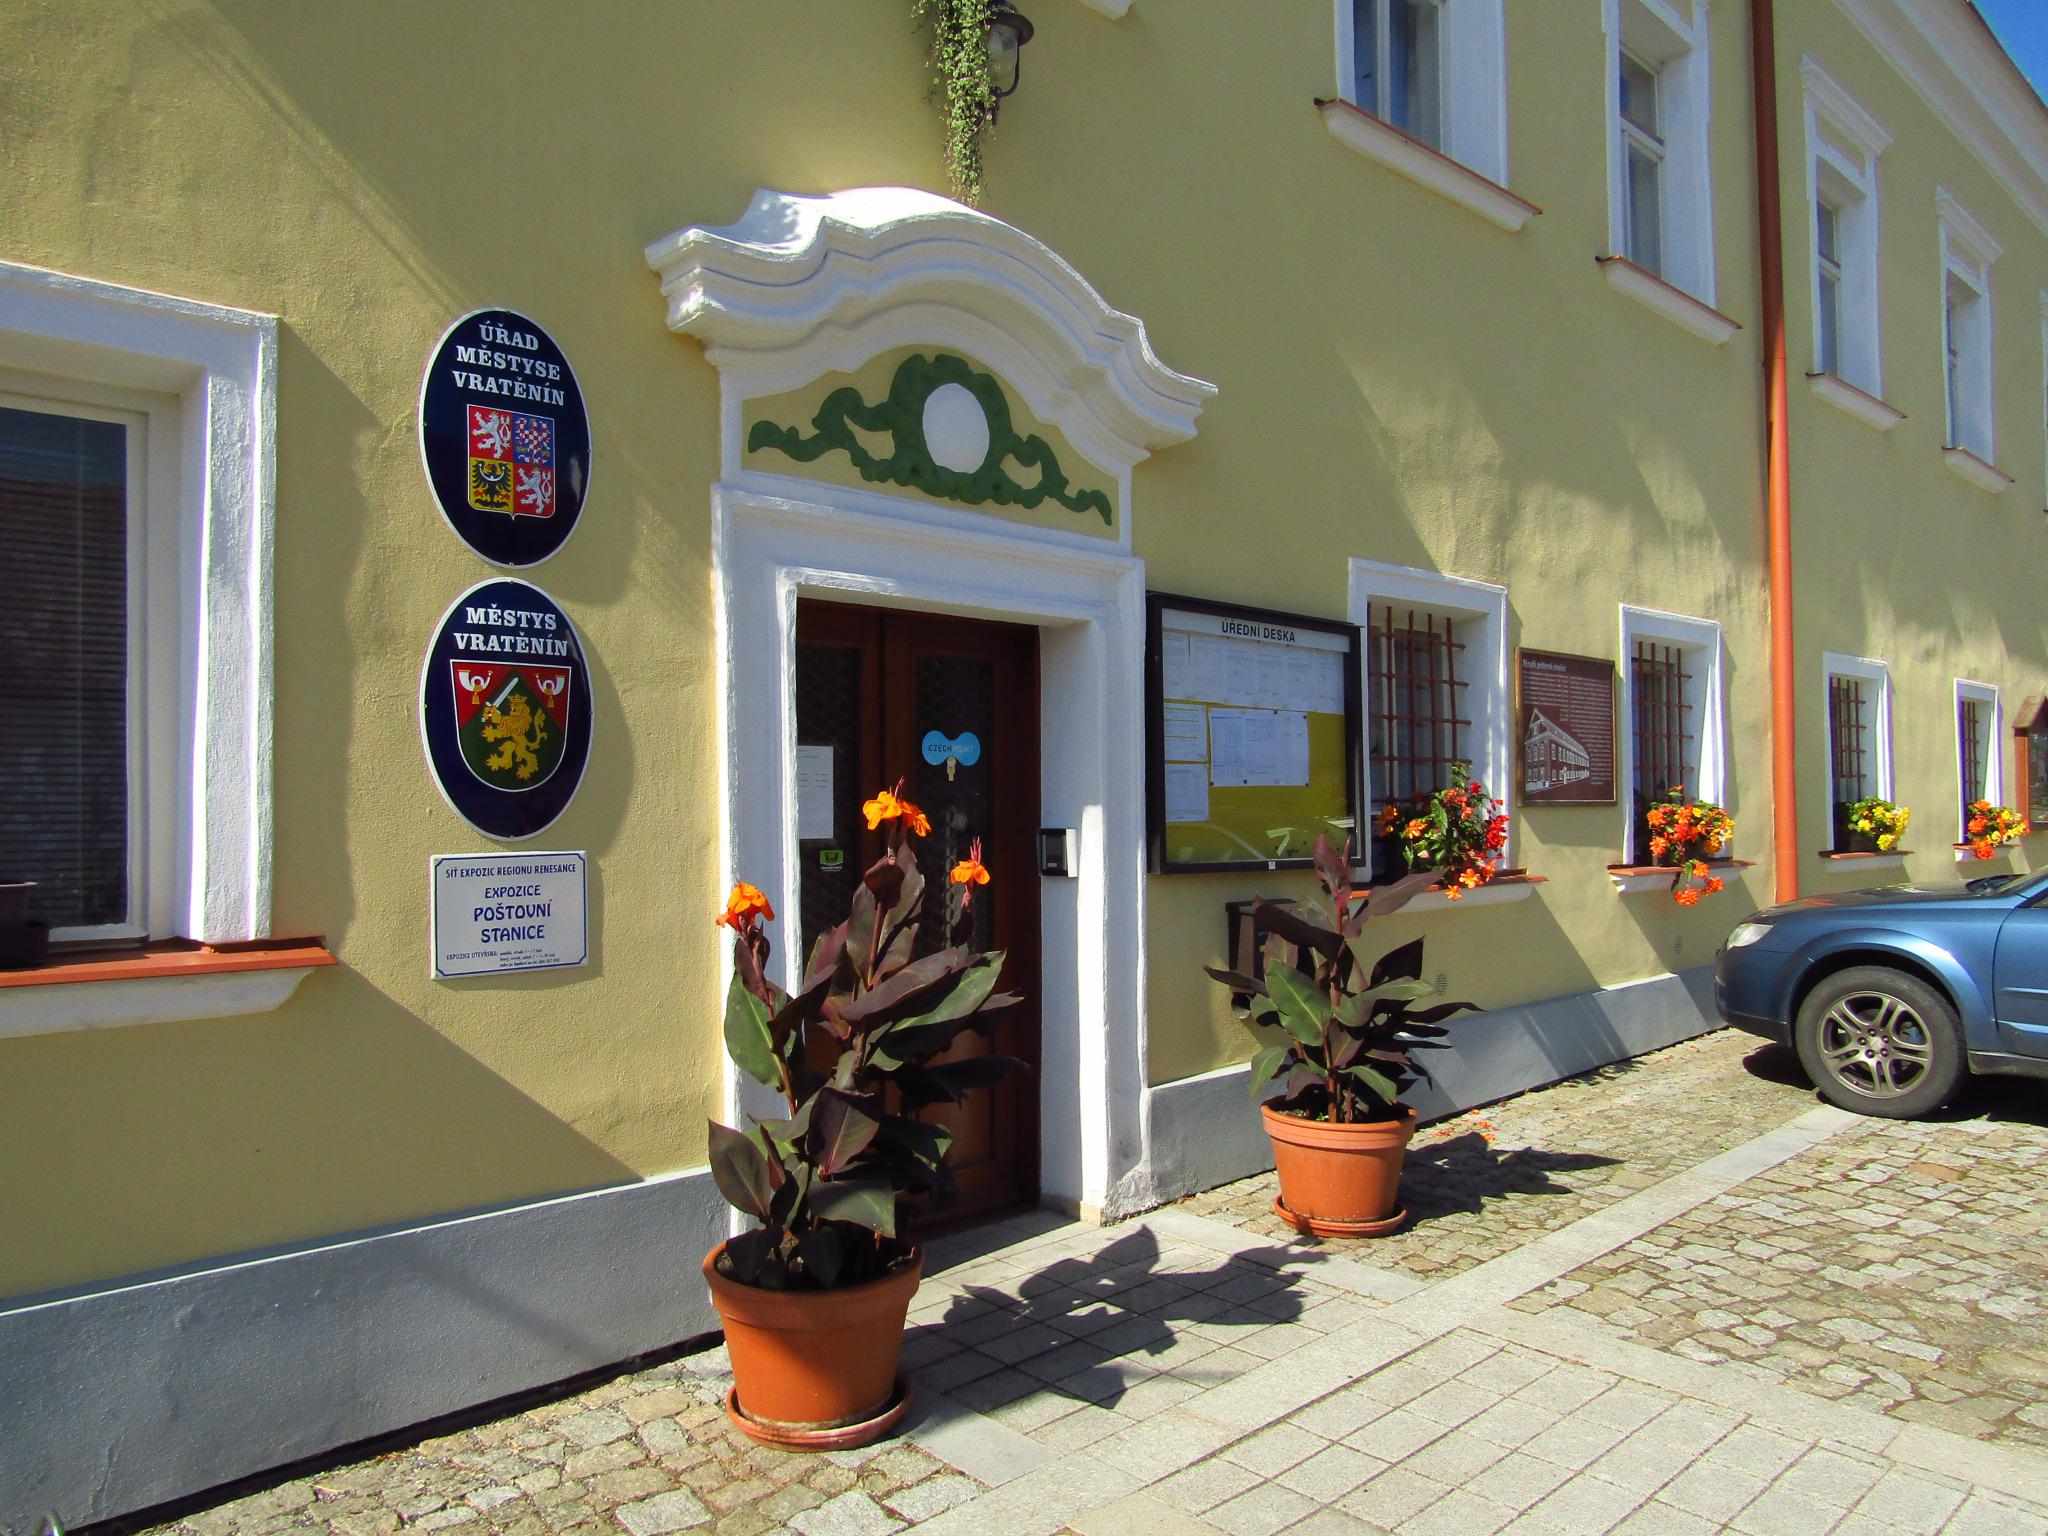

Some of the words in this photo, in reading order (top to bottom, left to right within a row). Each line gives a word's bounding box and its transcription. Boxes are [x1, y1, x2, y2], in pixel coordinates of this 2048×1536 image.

[479, 321, 539, 351] ÚŘAD
[456, 344, 561, 381] MĚSTYSE
[452, 370, 565, 407] VRATĚNÍN
[466, 603, 557, 630] MĚSTYS
[1222, 618, 1260, 638] ÚŘEDNÍ
[1263, 628, 1296, 643] DESKA
[453, 632, 568, 657] VRATĚNÍN
[928, 744, 952, 752] CZECH
[460, 867, 495, 878] EXPOZIC
[497, 865, 532, 876] REGIONU
[535, 863, 577, 874] RENESANCE
[485, 885, 541, 898] EXPOZICE
[474, 899, 553, 922] POŠTOVNÍ
[481, 925, 545, 943] STANICE
